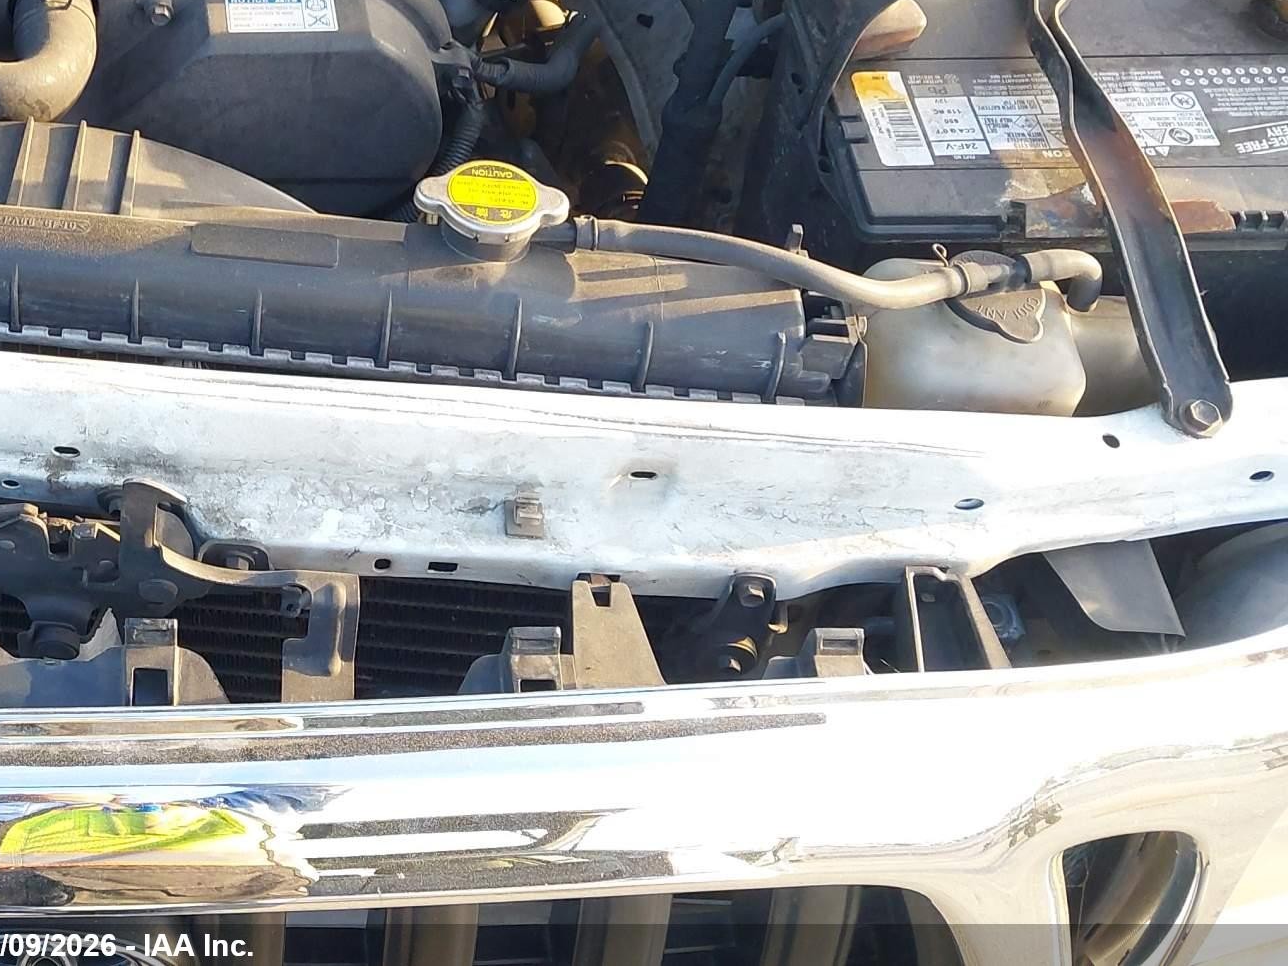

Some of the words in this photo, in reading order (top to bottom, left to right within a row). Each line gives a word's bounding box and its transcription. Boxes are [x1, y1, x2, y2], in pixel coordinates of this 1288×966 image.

[928, 87, 948, 95] Pb
[946, 142, 979, 151] 24F-V
[472, 168, 513, 179] CAUTION
